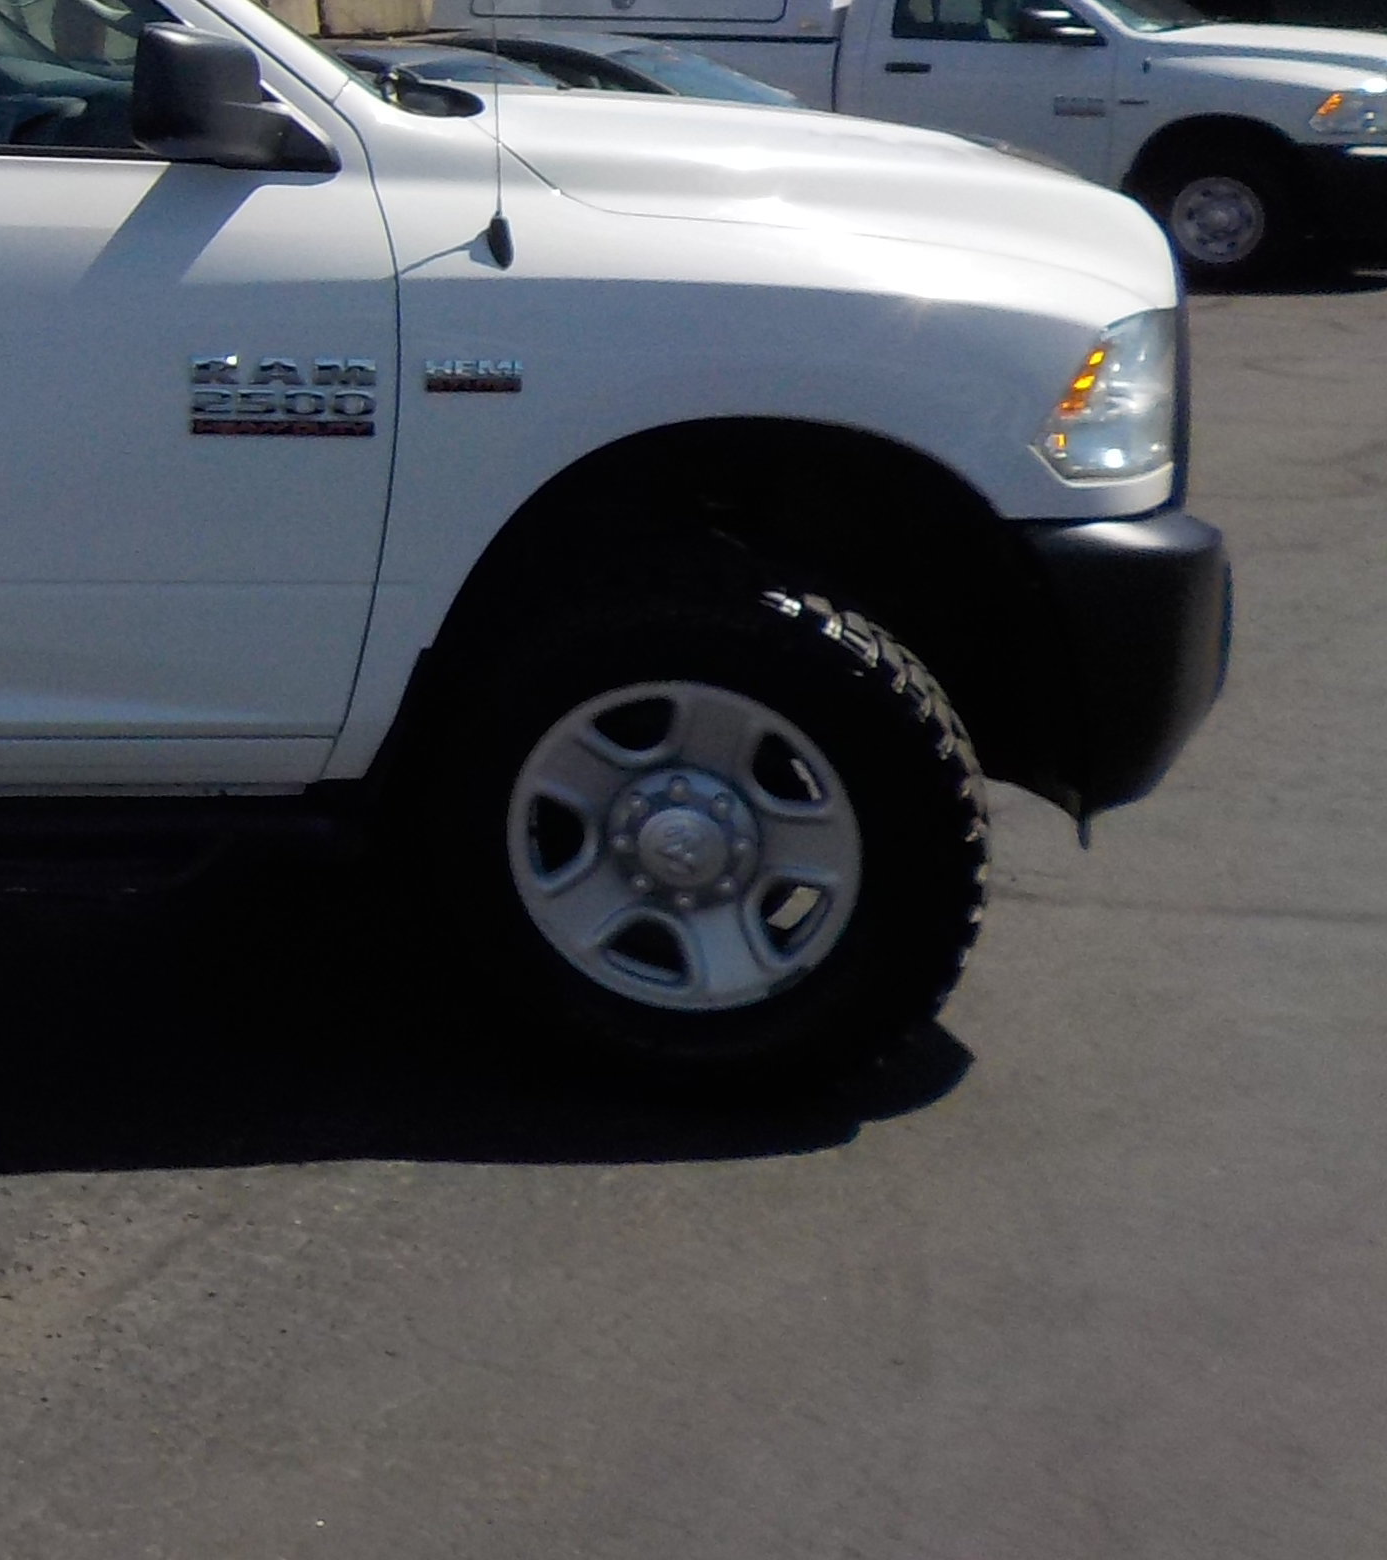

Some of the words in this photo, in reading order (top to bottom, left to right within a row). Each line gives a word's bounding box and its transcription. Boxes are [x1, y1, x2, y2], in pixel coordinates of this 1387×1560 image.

[190, 355, 376, 386] RAM
[425, 360, 524, 378] HEMI
[190, 388, 376, 417] 2500
